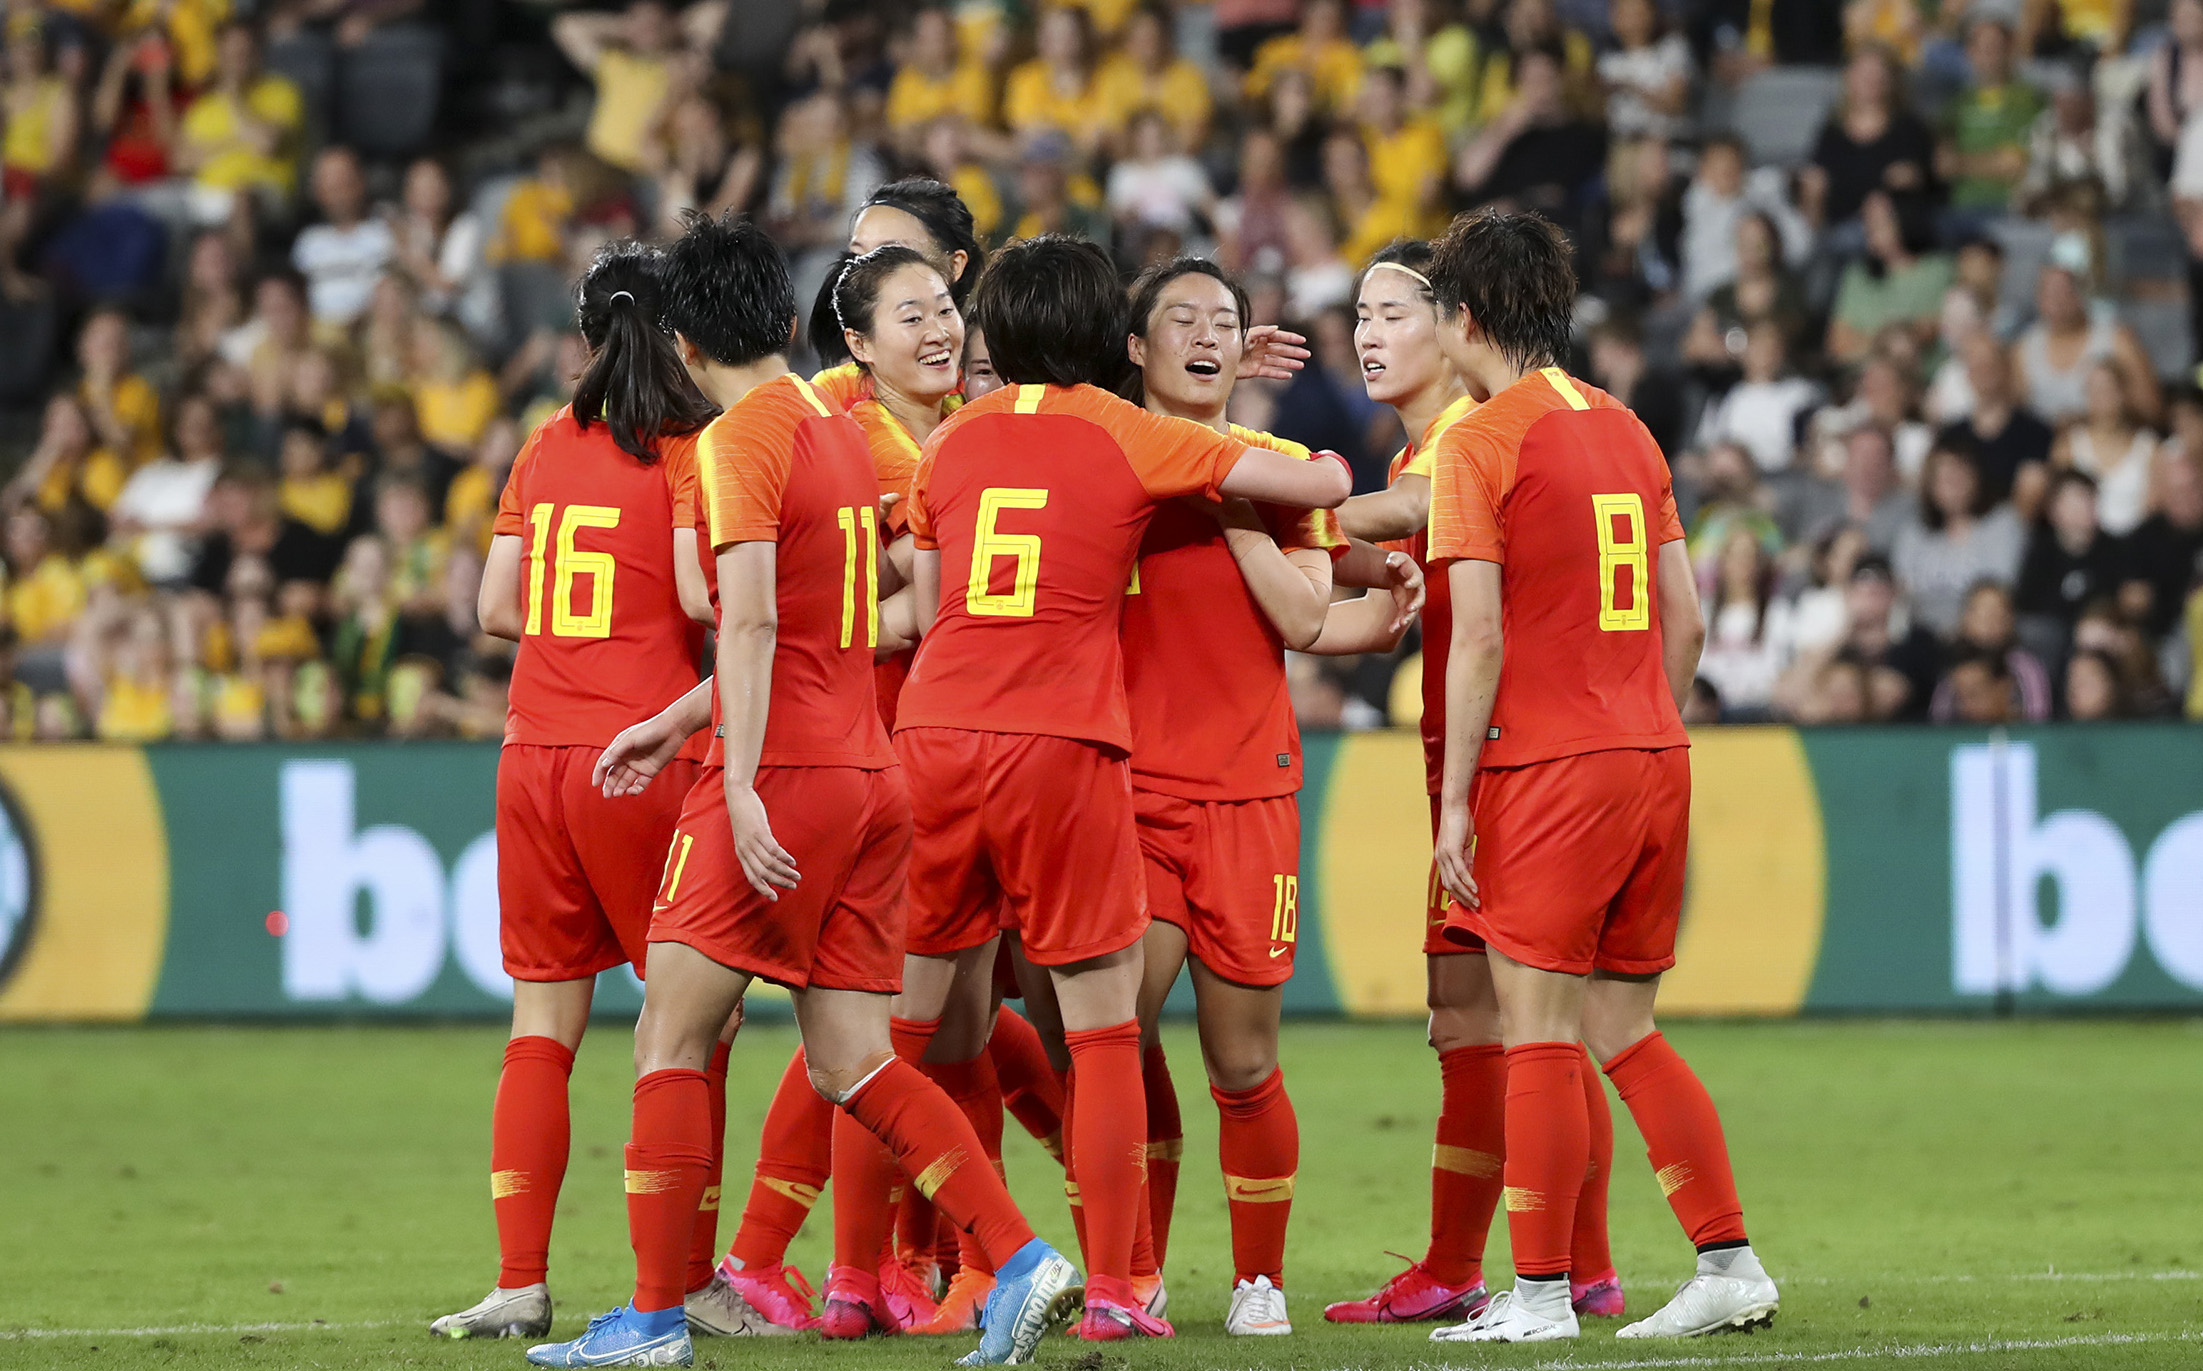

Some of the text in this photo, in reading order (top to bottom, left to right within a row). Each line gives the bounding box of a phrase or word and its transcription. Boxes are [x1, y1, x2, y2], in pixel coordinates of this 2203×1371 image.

[525, 503, 621, 638] 16
[838, 506, 879, 648] 11
[966, 488, 1048, 616] 6
[1591, 493, 1649, 631] 8
[658, 829, 693, 902] 11
[1271, 874, 1297, 942] 18
